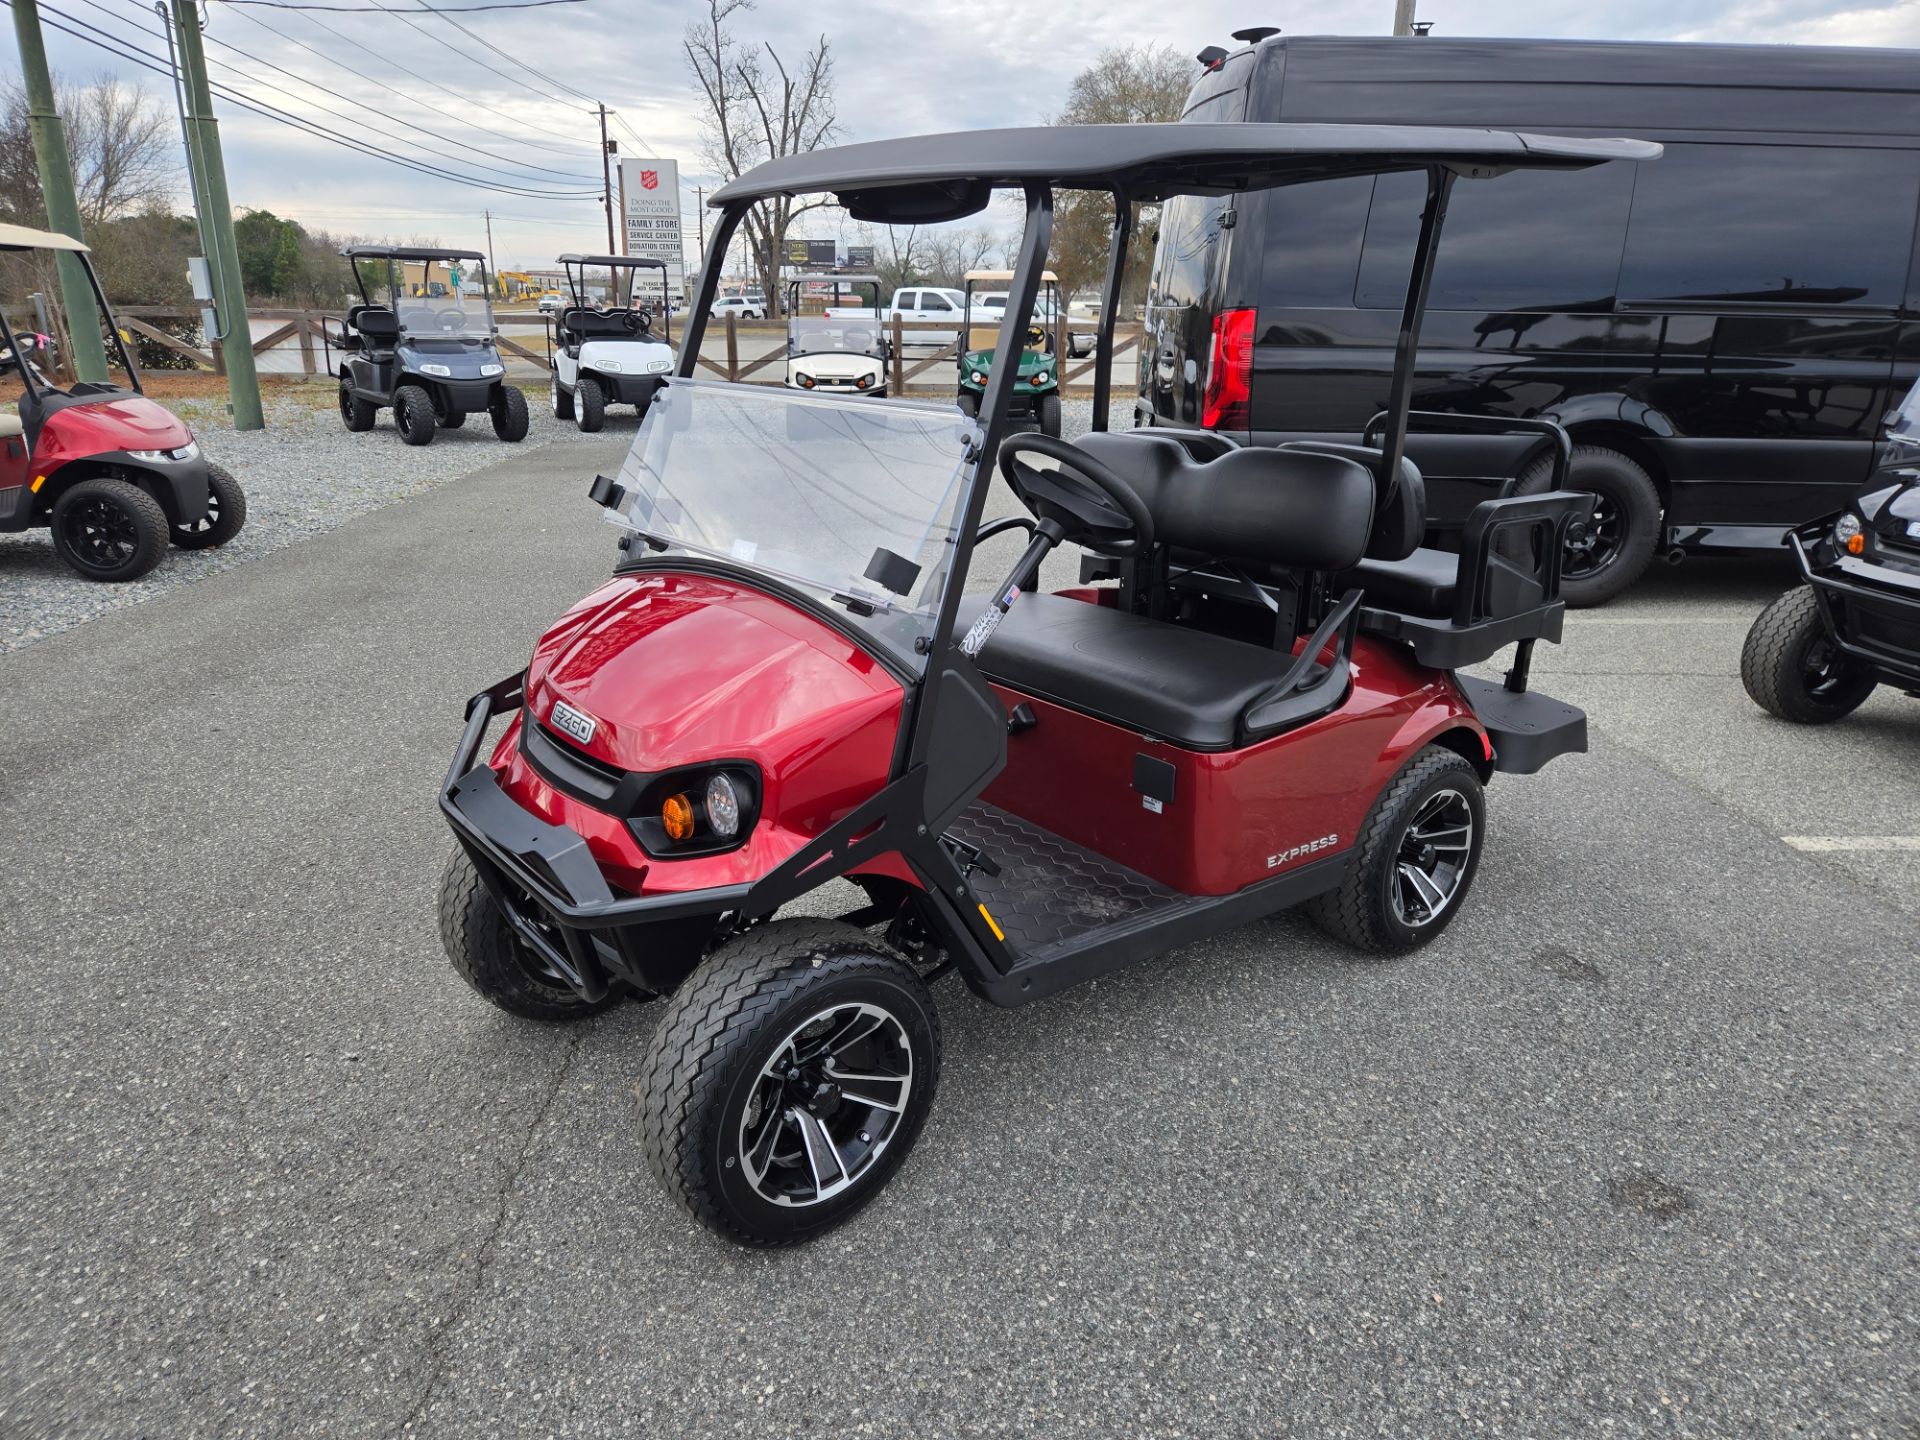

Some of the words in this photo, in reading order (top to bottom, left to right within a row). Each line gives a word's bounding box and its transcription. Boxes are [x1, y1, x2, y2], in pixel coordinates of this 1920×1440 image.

[628, 219, 653, 228] FAMILY
[655, 220, 678, 229] STORE
[629, 231, 653, 239] SERVICE
[655, 232, 678, 240] CENTER
[629, 242, 658, 250] DONATION
[659, 243, 681, 251] CENTER
[554, 704, 591, 739] EZGO
[1267, 833, 1338, 869] EXPRESS
